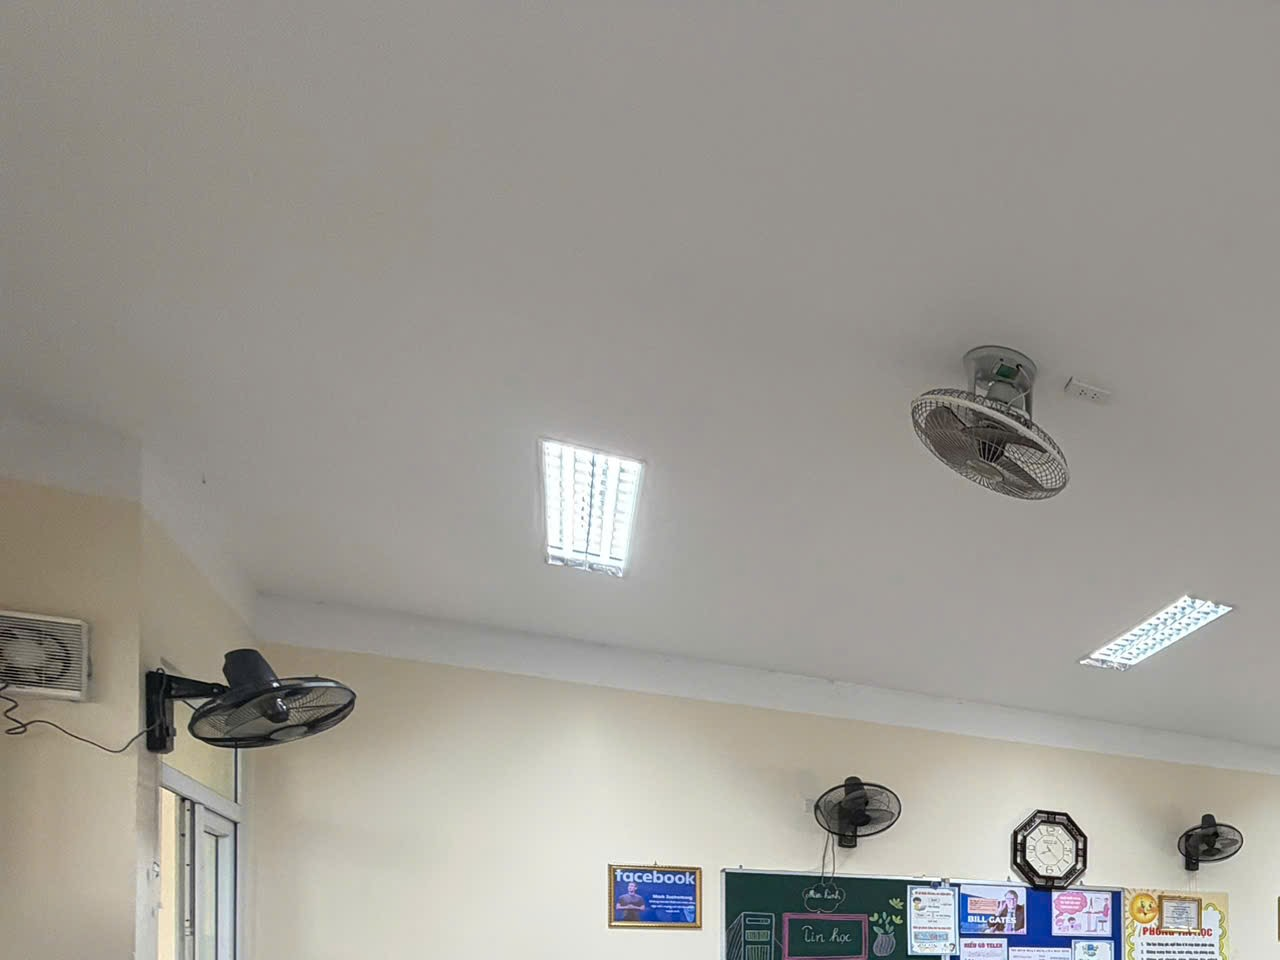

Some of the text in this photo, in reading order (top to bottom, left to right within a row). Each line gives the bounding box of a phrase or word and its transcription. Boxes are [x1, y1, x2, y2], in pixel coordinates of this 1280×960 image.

[615, 869, 695, 885] facebook
[967, 915, 1016, 924] BILL GATES
